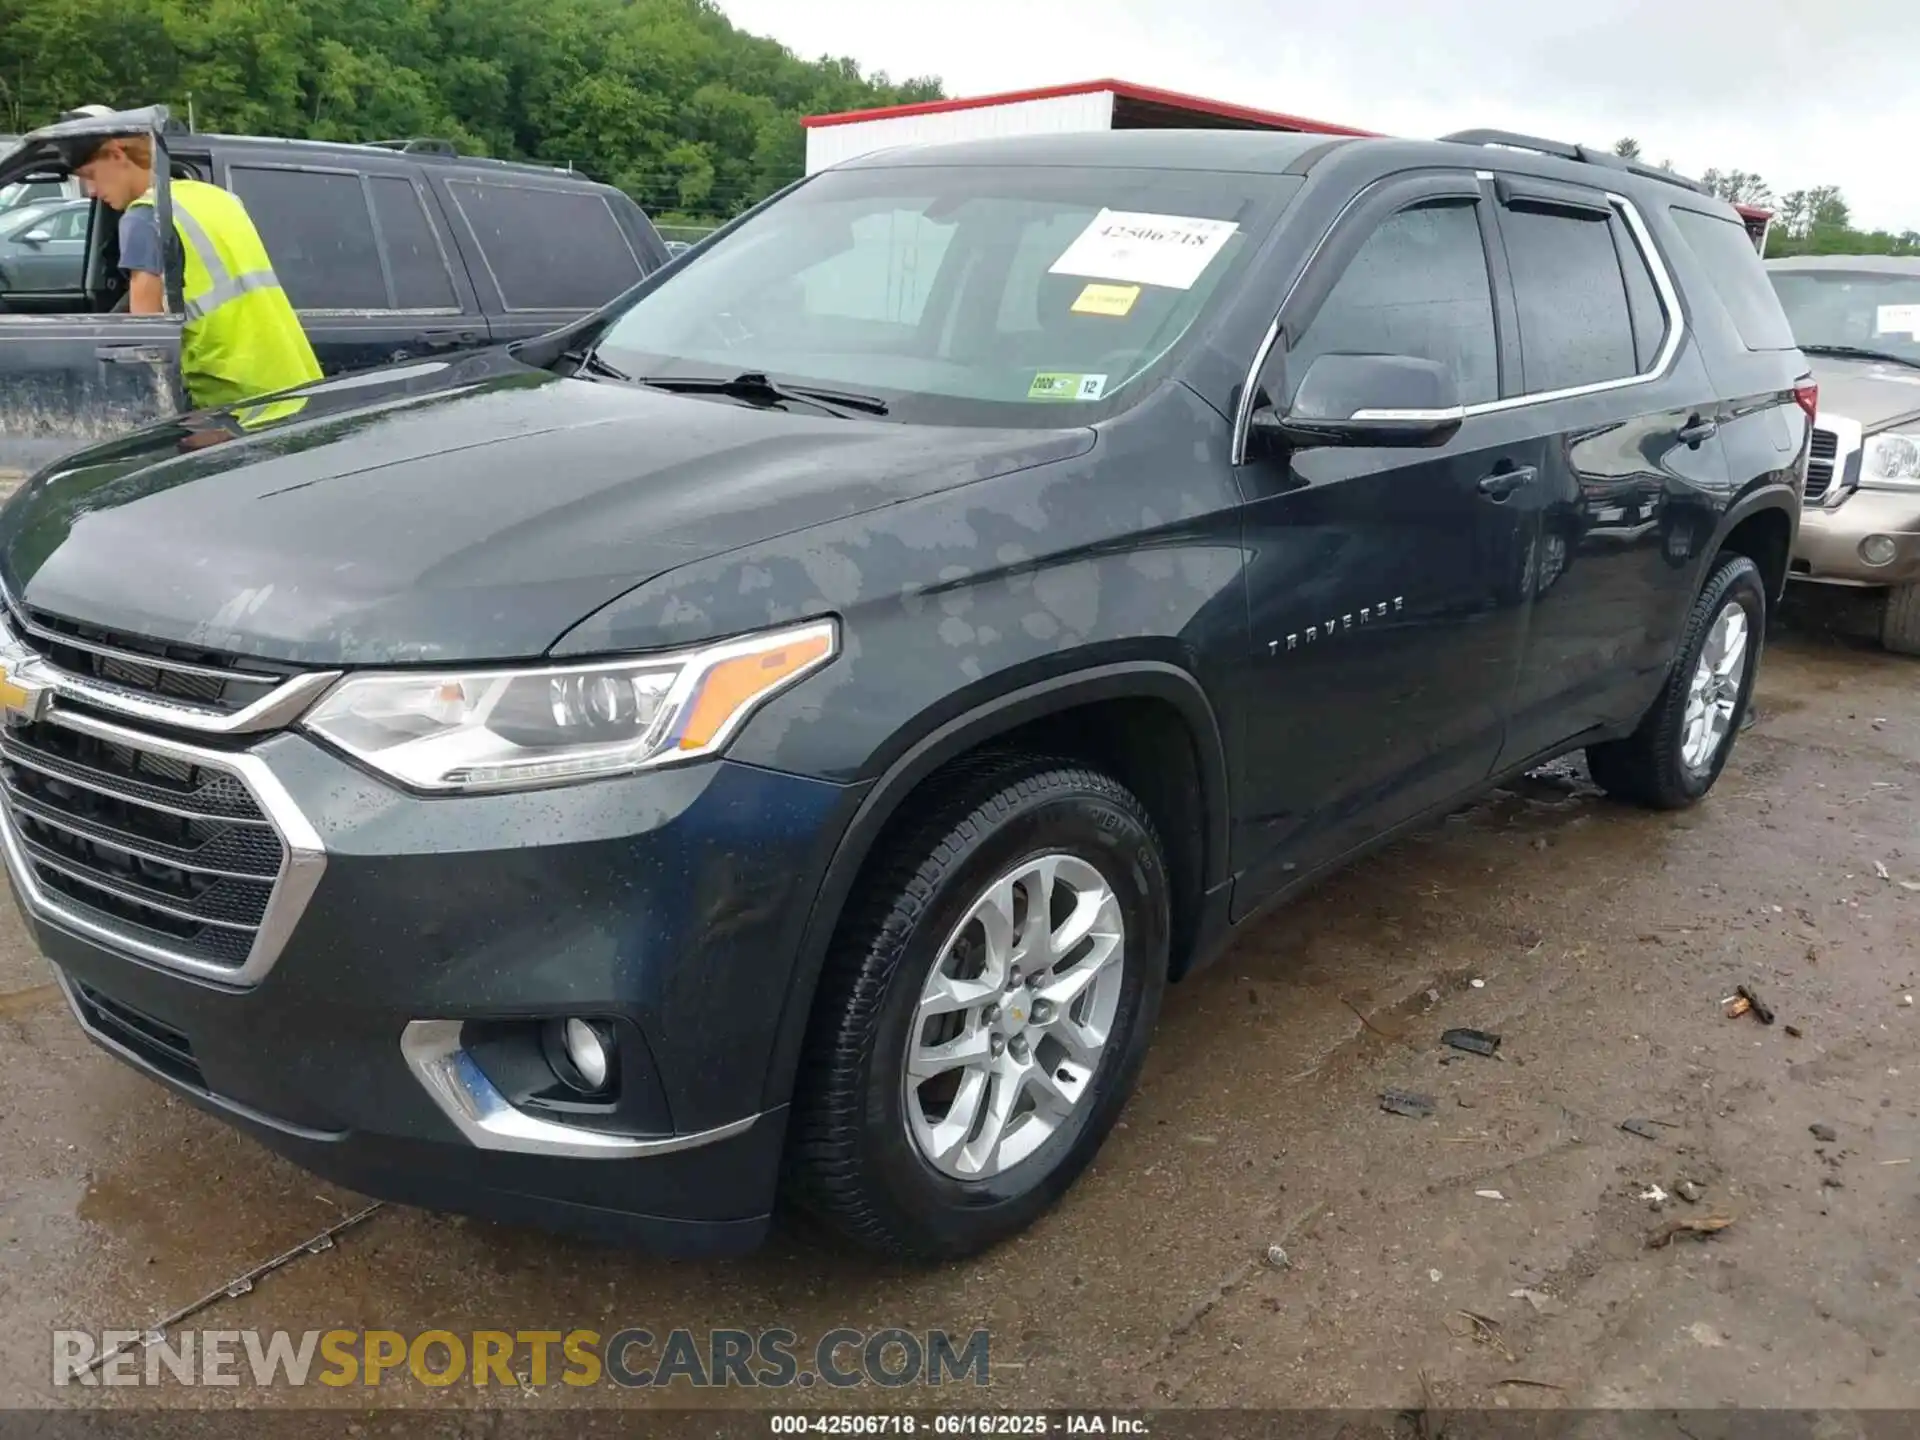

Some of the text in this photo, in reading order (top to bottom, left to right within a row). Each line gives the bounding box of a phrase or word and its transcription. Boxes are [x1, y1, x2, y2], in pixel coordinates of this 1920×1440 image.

[1100, 224, 1209, 247] 42506718
[1083, 380, 1098, 394] 12
[1267, 595, 1403, 656] TRAVERSE
